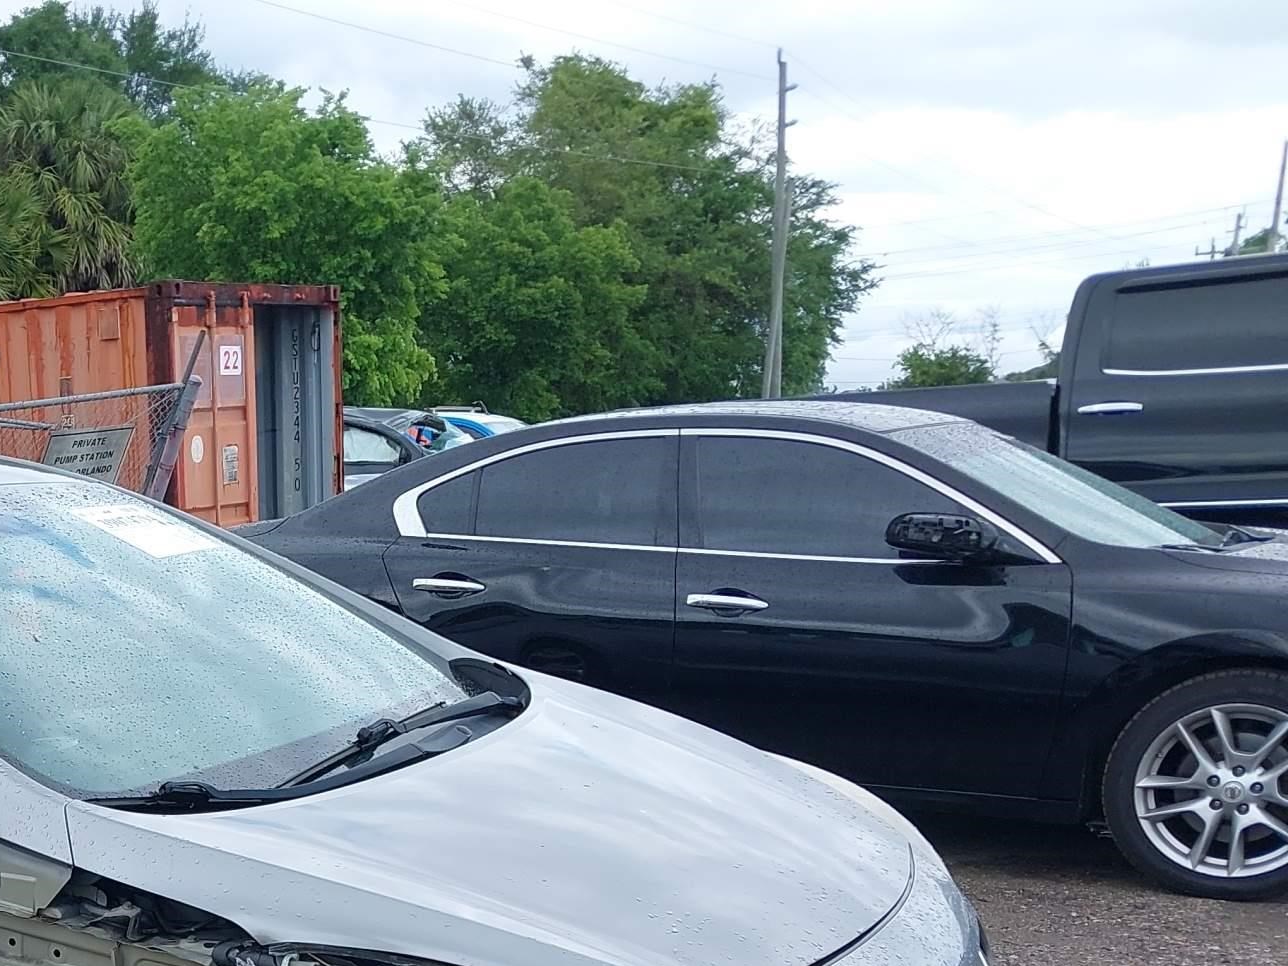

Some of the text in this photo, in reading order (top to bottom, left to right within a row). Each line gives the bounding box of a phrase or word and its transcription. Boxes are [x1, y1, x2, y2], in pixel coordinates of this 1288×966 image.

[223, 350, 239, 370] 22
[71, 437, 108, 449] PRIVATE
[54, 450, 115, 465] PUMP STATION
